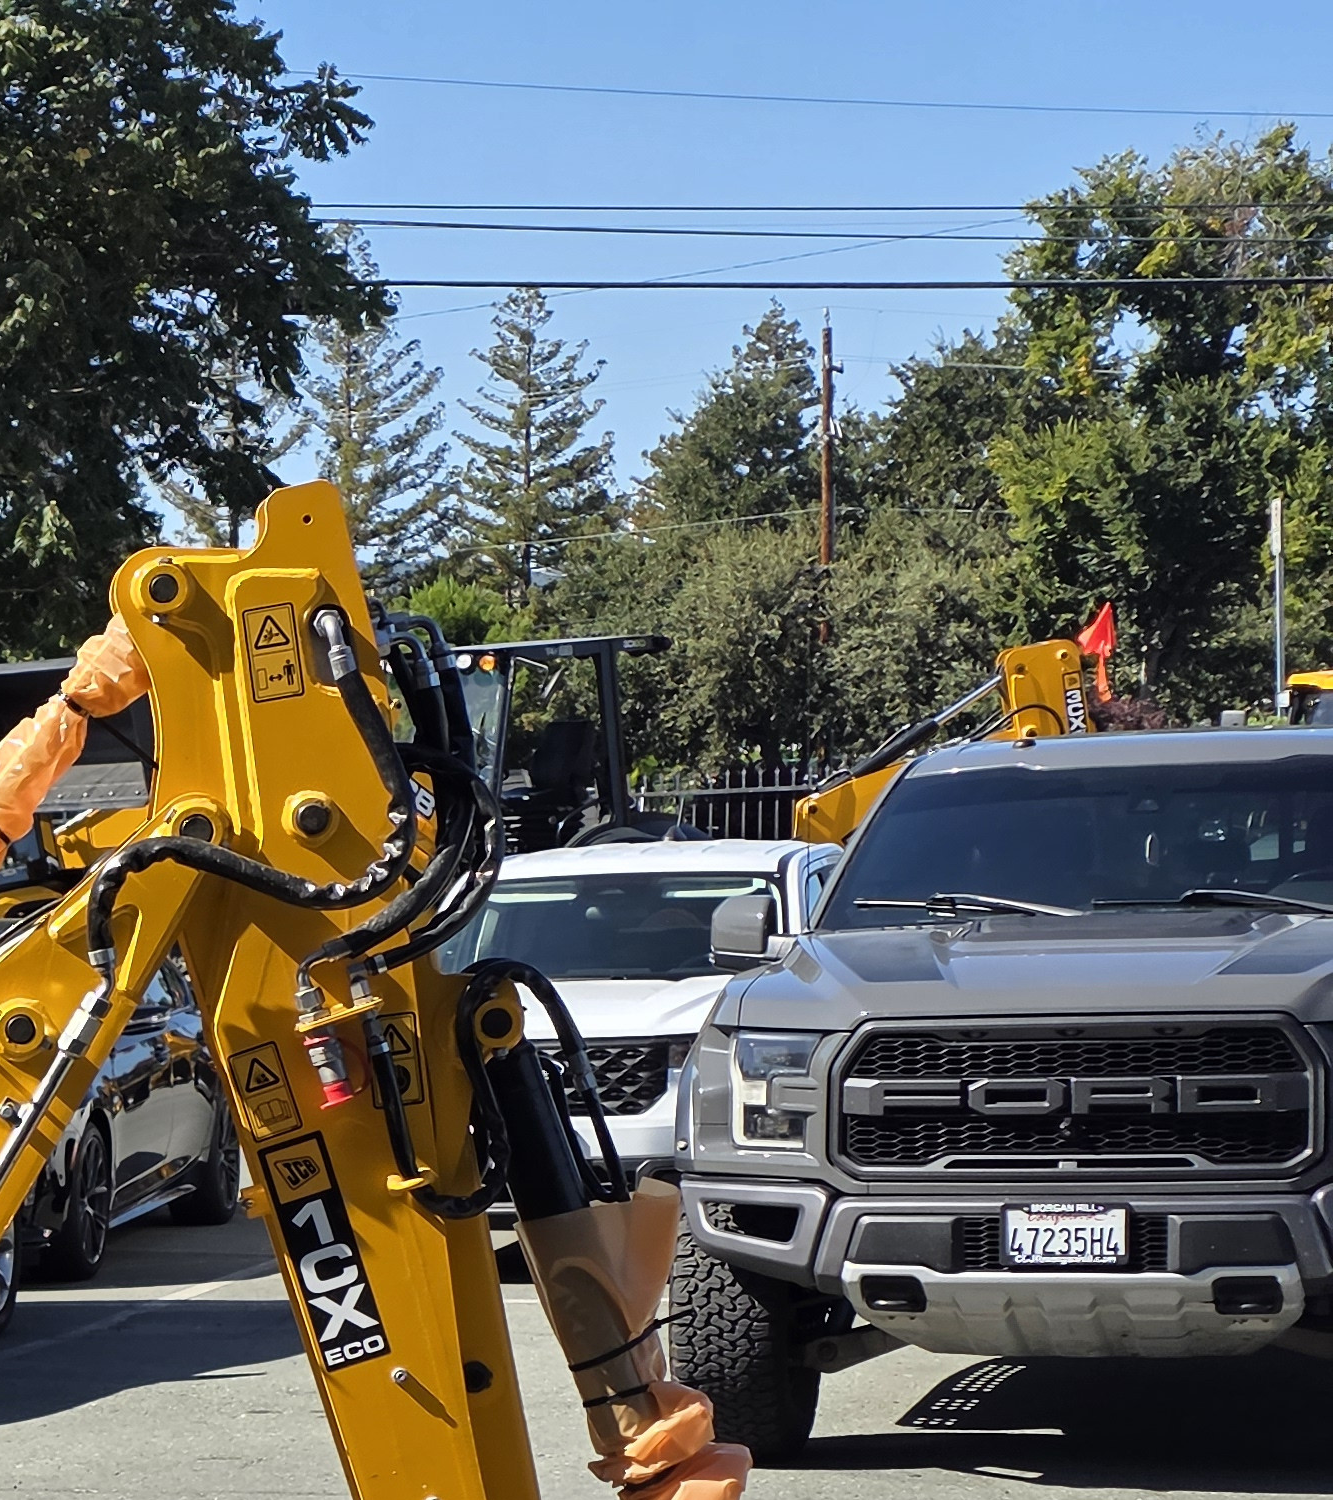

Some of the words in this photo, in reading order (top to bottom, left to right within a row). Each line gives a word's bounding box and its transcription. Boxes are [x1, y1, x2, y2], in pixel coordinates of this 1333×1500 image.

[1066, 689, 1086, 731] 3CX
[844, 1076, 1288, 1115] FORD
[282, 1158, 318, 1186] JCB
[1009, 1227, 1120, 1256] 47235H4
[291, 1198, 380, 1343] 1CX
[324, 1334, 385, 1367] ECO
